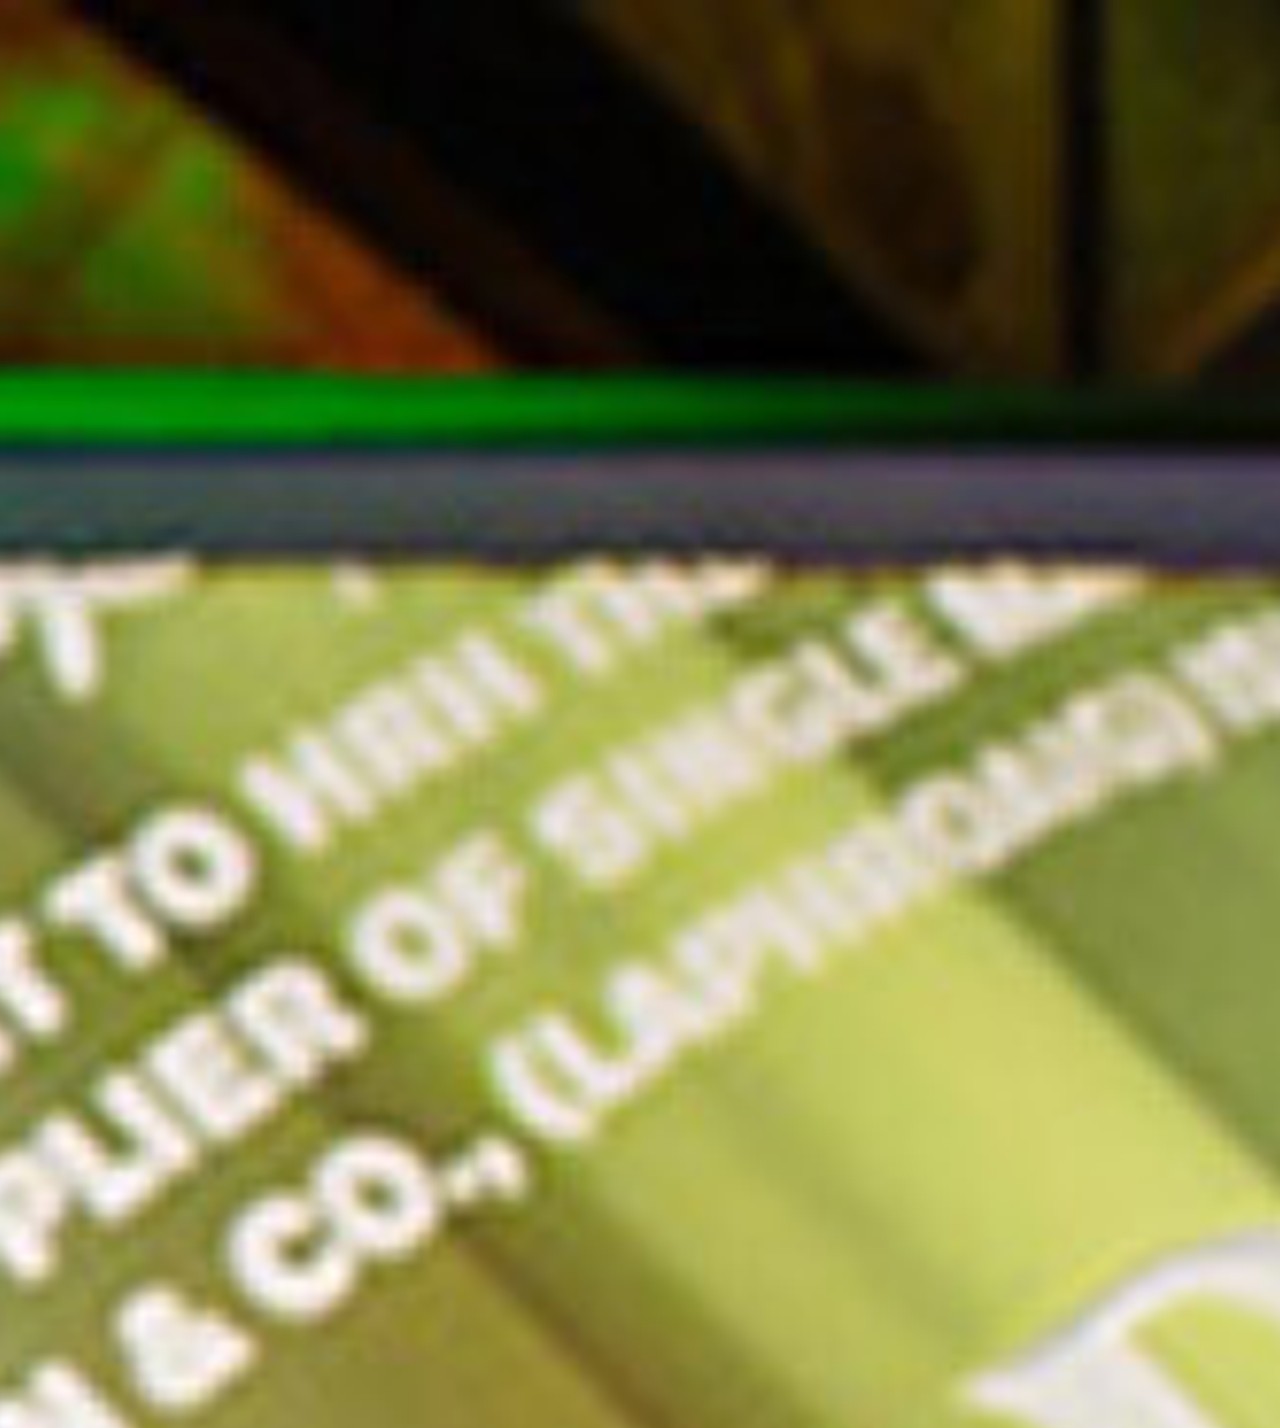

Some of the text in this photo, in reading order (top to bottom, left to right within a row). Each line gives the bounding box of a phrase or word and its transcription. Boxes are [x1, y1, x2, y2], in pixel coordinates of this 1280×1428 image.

[42, 803, 257, 970] TO
[345, 832, 525, 1002] OF
[128, 1287, 253, 1412] &
